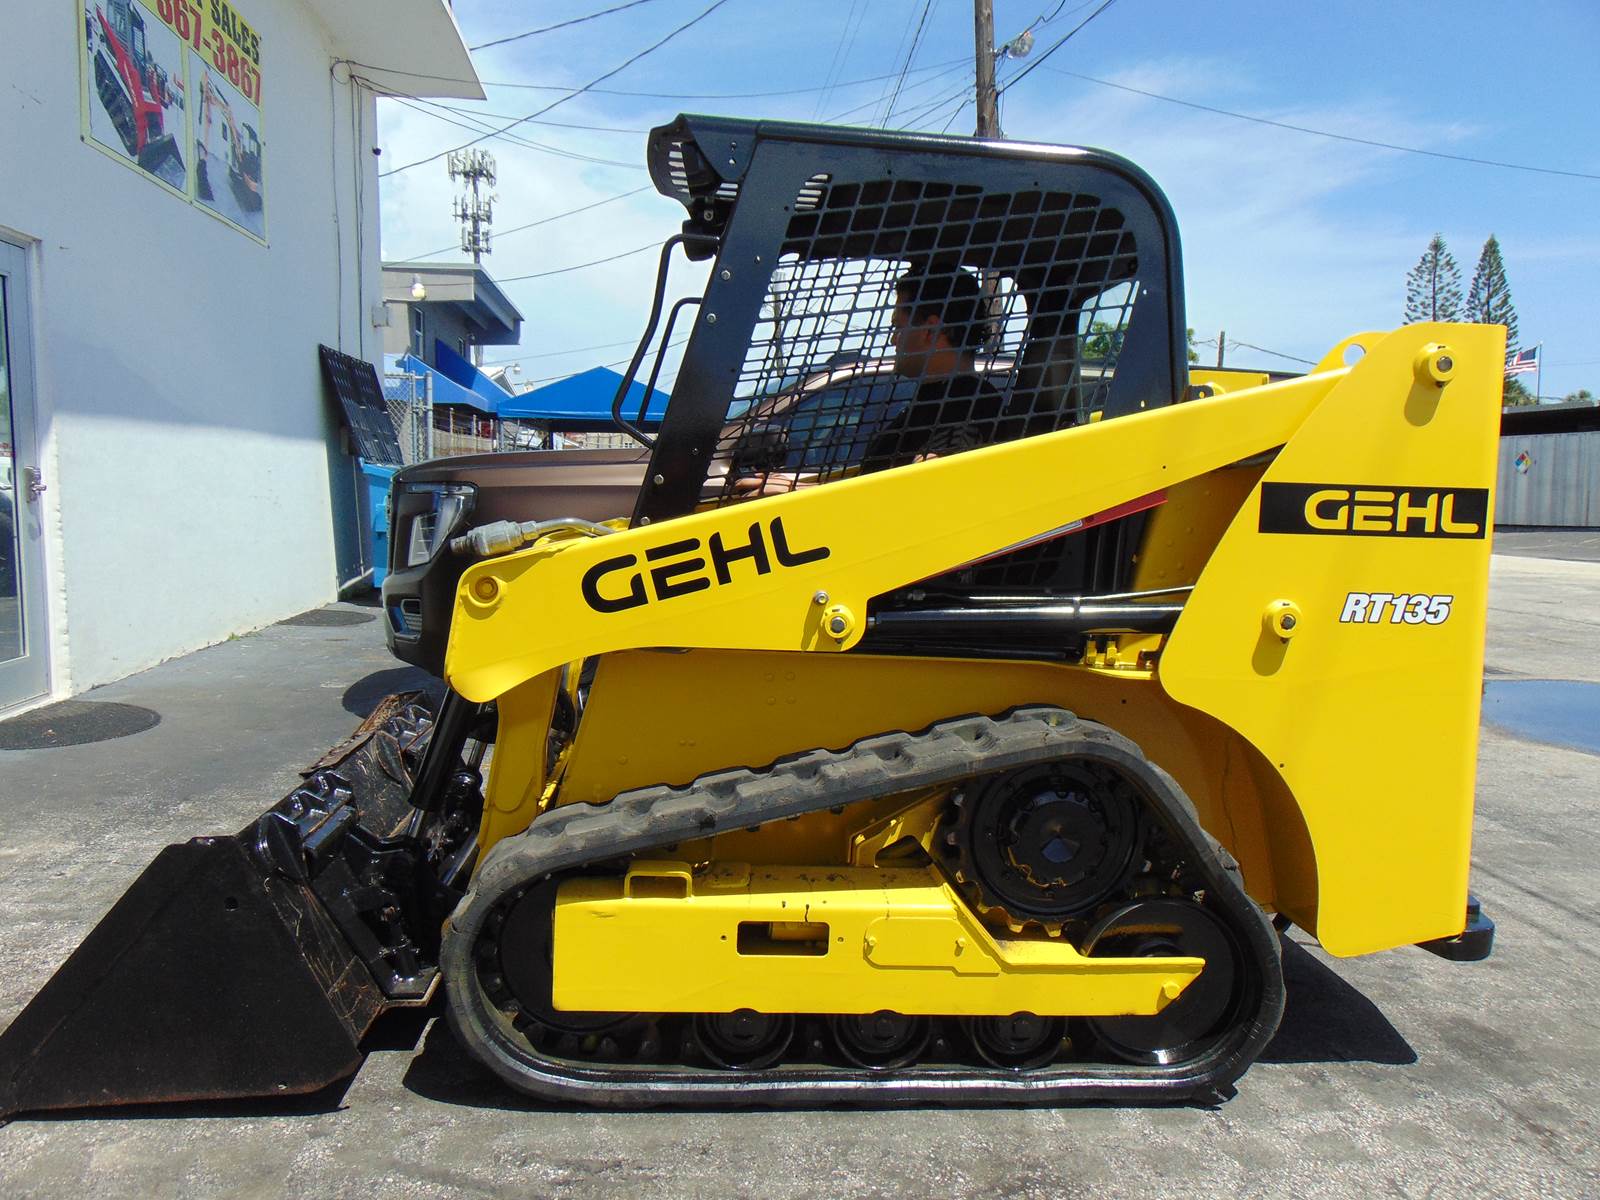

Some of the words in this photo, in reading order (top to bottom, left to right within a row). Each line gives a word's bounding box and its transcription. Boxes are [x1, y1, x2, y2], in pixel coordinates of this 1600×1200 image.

[210, 0, 260, 65] SALES
[1304, 490, 1479, 534] GEHL
[582, 516, 830, 613] GEHL
[1340, 592, 1453, 624] RT135
